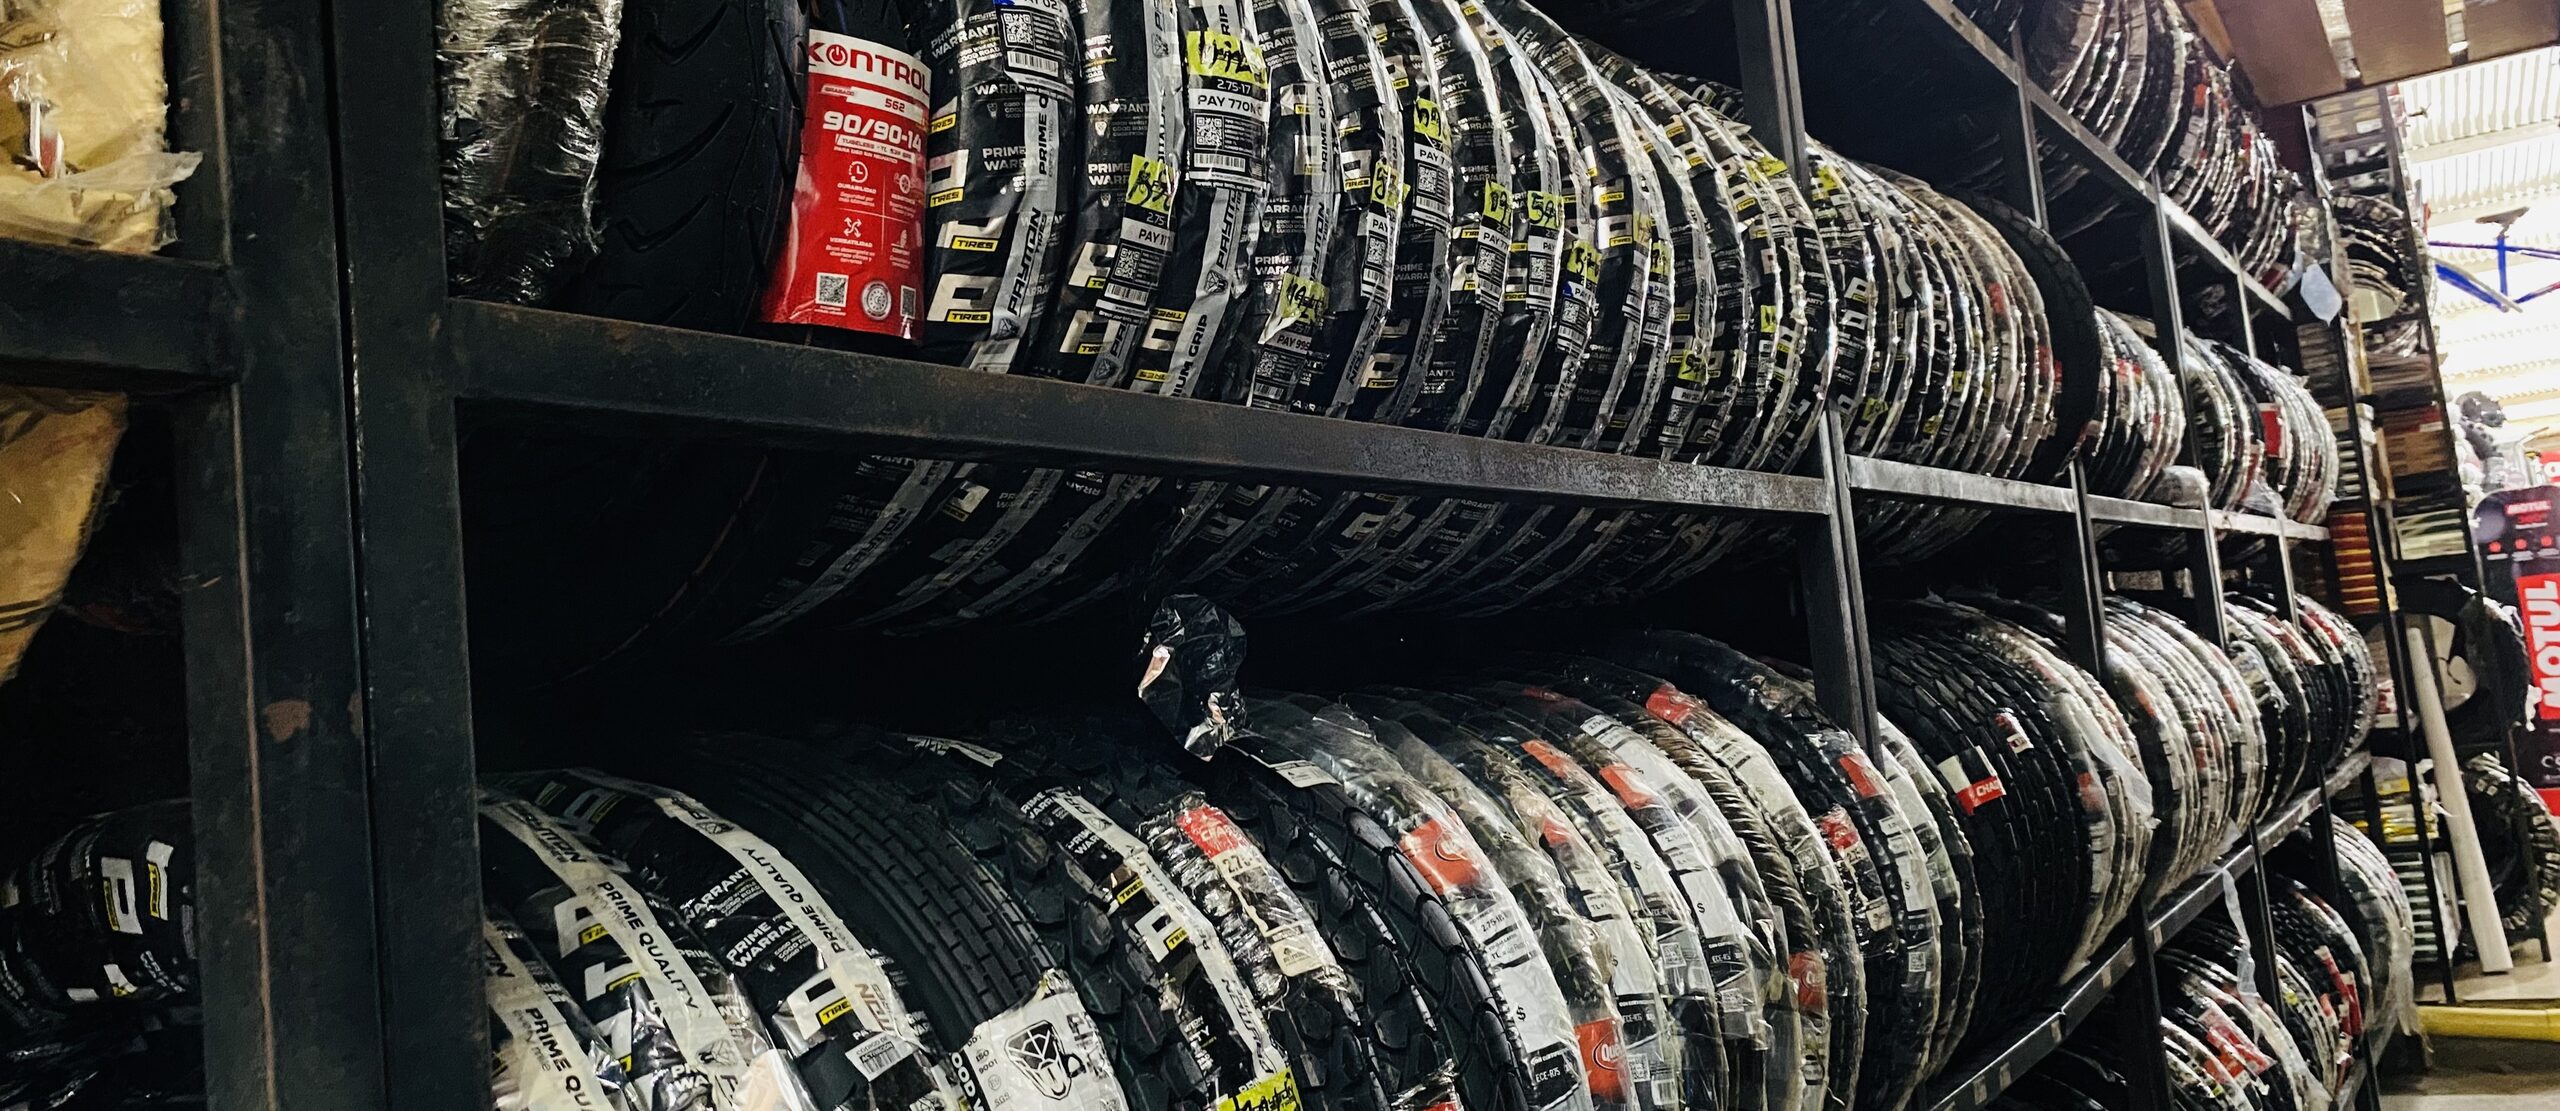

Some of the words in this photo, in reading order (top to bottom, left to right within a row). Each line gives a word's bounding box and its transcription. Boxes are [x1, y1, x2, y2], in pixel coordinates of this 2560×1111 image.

[931, 18, 965, 49] PRIME
[1217, 79, 1251, 95] 2.75-17
[885, 98, 906, 112] 562
[1198, 95, 1225, 107] PAY
[823, 110, 922, 154] 90/90-14
[983, 146, 1026, 158] PRIME
[1038, 113, 1048, 175] PRIME
[1420, 150, 1439, 160] PAY
[1088, 163, 1130, 174] PRIME
[933, 190, 959, 204] TIRES
[1371, 218, 1388, 234] PAY
[956, 239, 994, 249] TIRES
[1139, 229, 1159, 245] PAY
[1483, 231, 1502, 245] PAY
[1007, 206, 1042, 317] PAYTON
[951, 312, 989, 321] TIRES
[1188, 314, 1208, 357] GRIP
[1277, 336, 1296, 348] PAY
[2524, 580, 2560, 710] MOTUL
[742, 847, 804, 904] QUALITY
[800, 904, 846, 954] PRIME
[597, 881, 645, 931] PRIME
[639, 933, 699, 1010] QUALITY
[726, 921, 772, 962] PRIME
[1517, 1006, 1527, 1021] $
[524, 1007, 572, 1072] PRIME
[975, 1049, 990, 1062] ISO
[978, 1058, 999, 1075] 9001
[1535, 1066, 1561, 1083] ECE-R75
